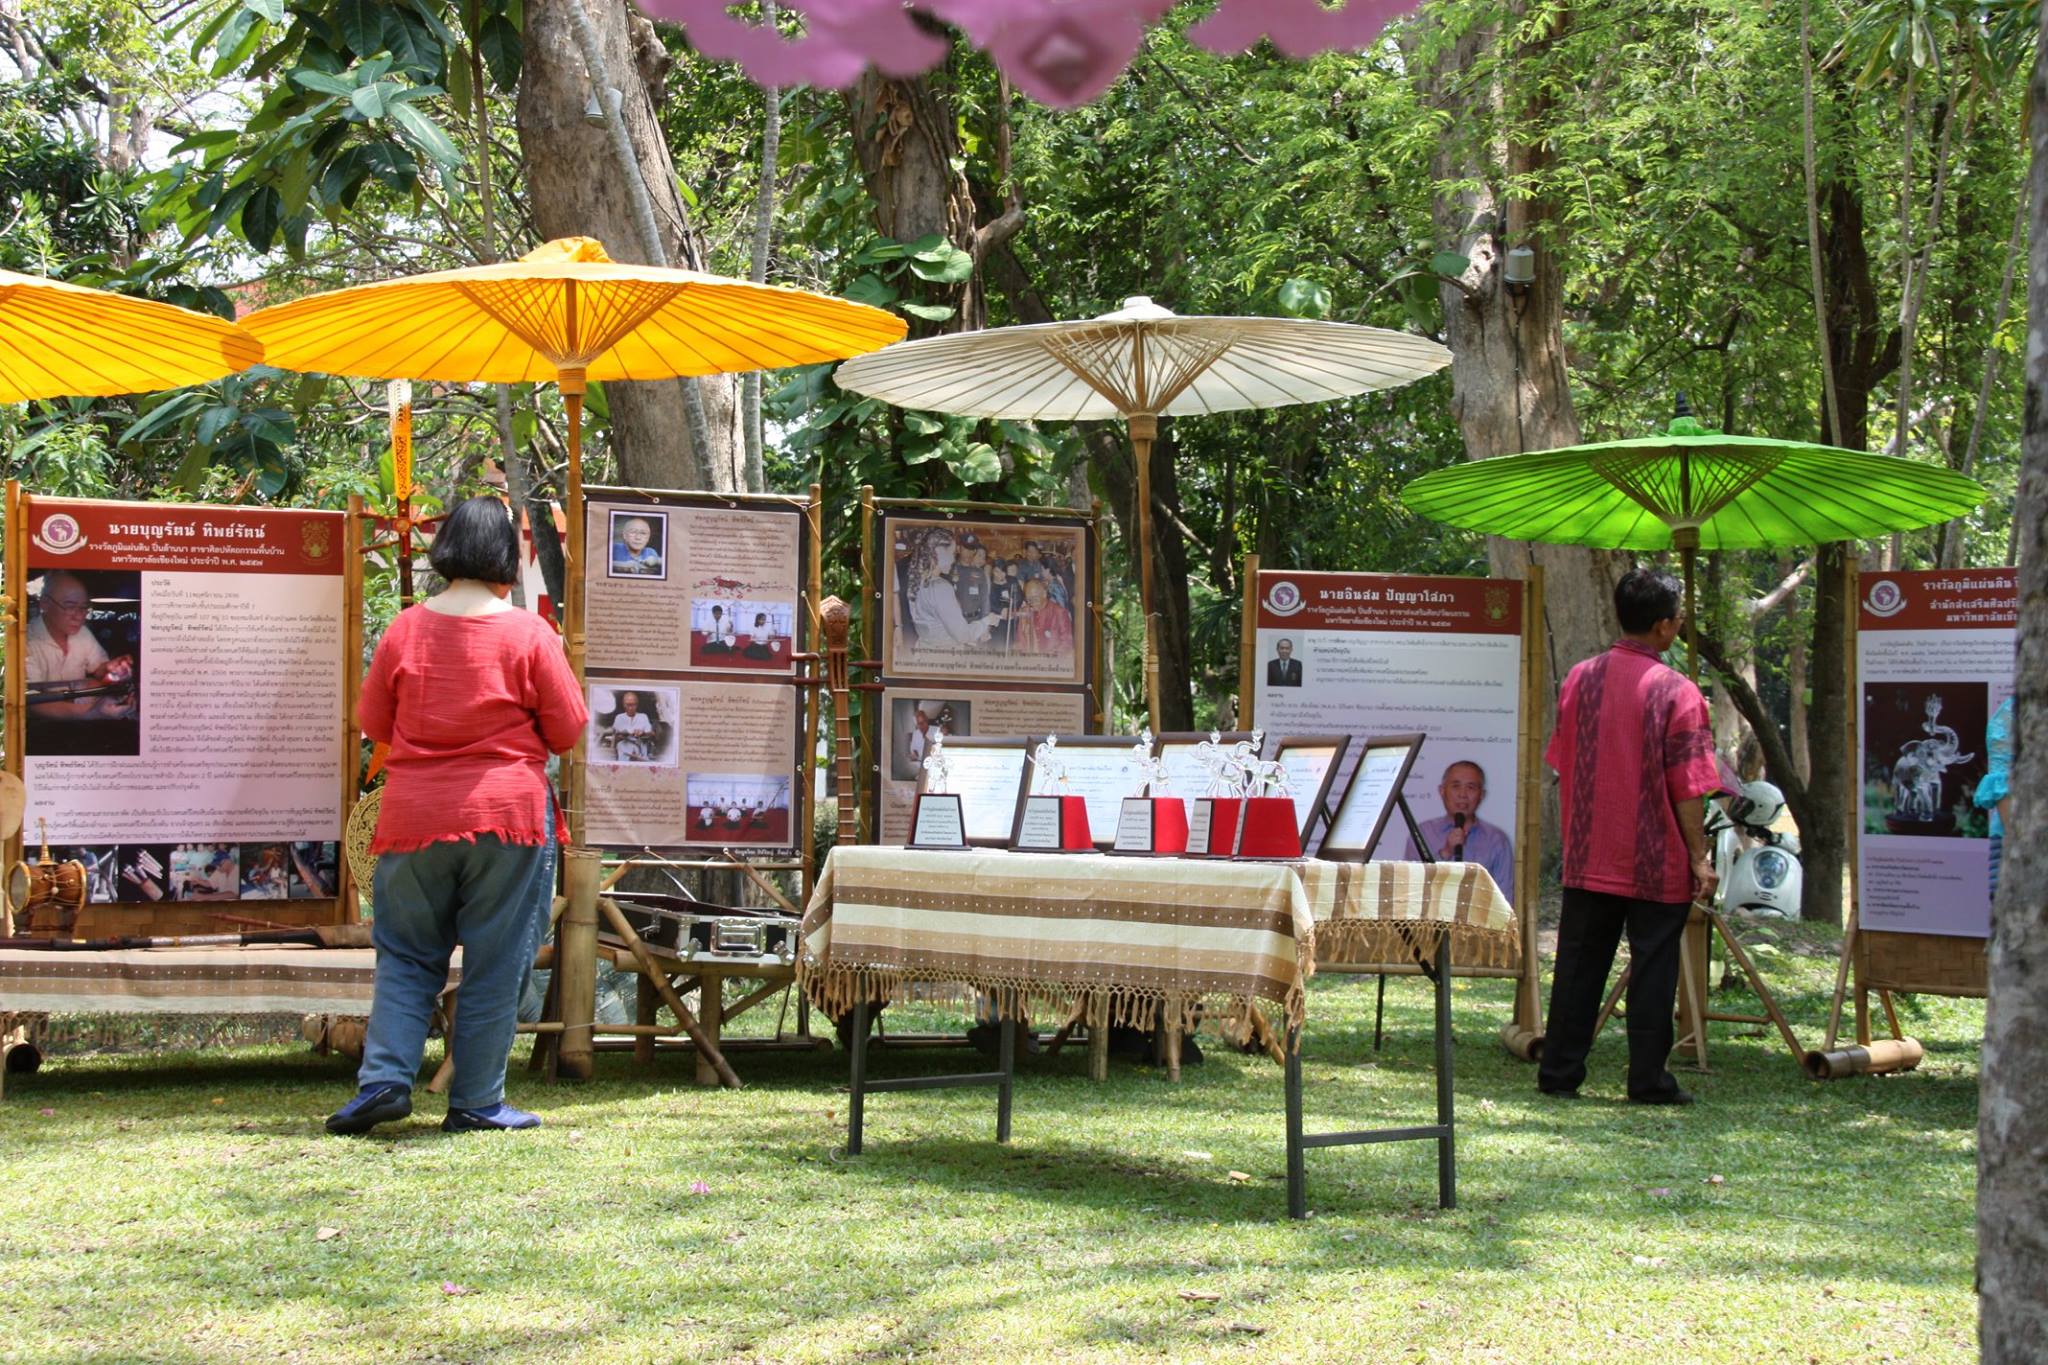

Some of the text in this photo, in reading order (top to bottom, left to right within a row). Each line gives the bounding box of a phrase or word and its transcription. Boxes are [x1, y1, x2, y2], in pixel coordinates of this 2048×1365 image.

[108, 521, 266, 540] นายบุญรัตน์ ทิพย์รัตน์
[88, 542, 150, 553] รางวัลภูมิแผ่นดิน
[111, 554, 188, 564] มหาวิทยาลัยเชียงใหม่
[1923, 577, 2011, 593] รางวัลภูมิแผ่นดิน
[1319, 587, 1455, 604] นายอินสม ปัญญาโสภา
